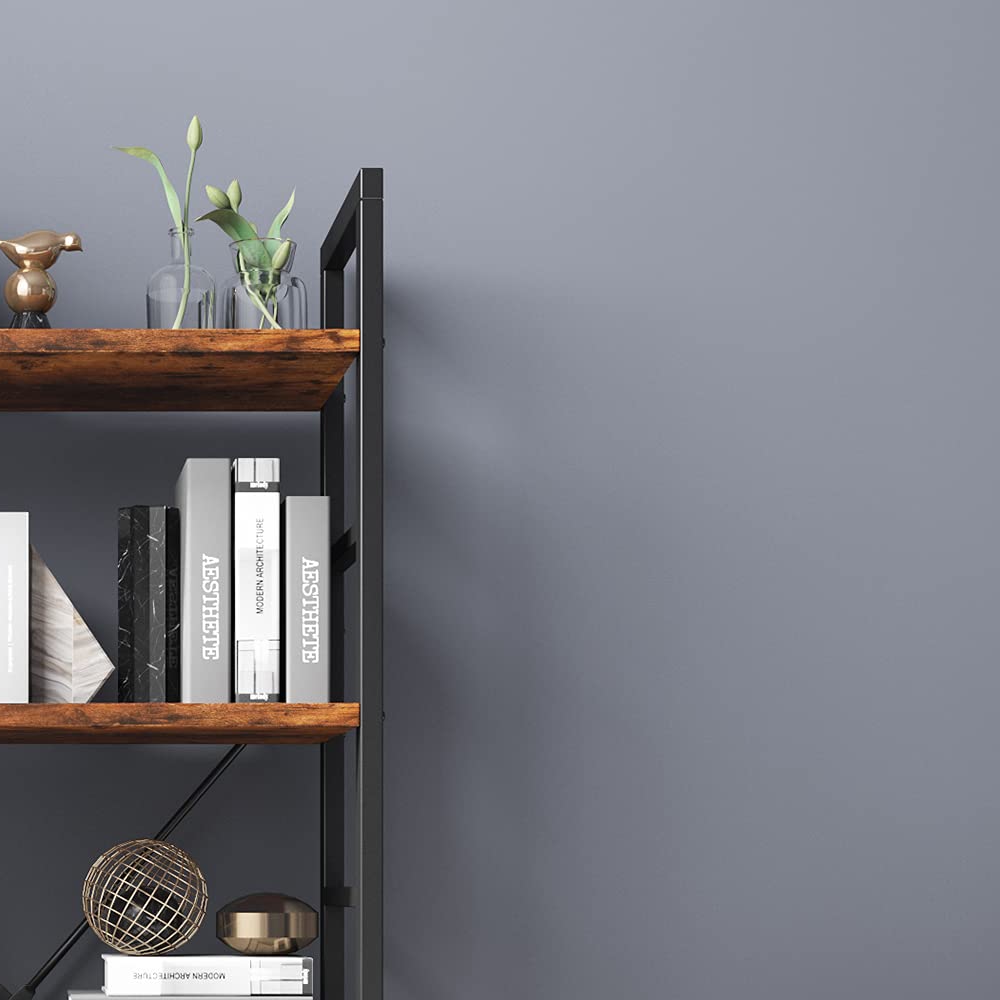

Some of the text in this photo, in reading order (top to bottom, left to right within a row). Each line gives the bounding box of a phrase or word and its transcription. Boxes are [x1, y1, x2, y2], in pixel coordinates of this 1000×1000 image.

[202, 554, 219, 661] AESTHETE
[256, 517, 264, 614] MODERN ARCHITECTURE
[302, 557, 319, 663] AESTHETE
[133, 972, 226, 980] MODERN ARCHITECTURE
